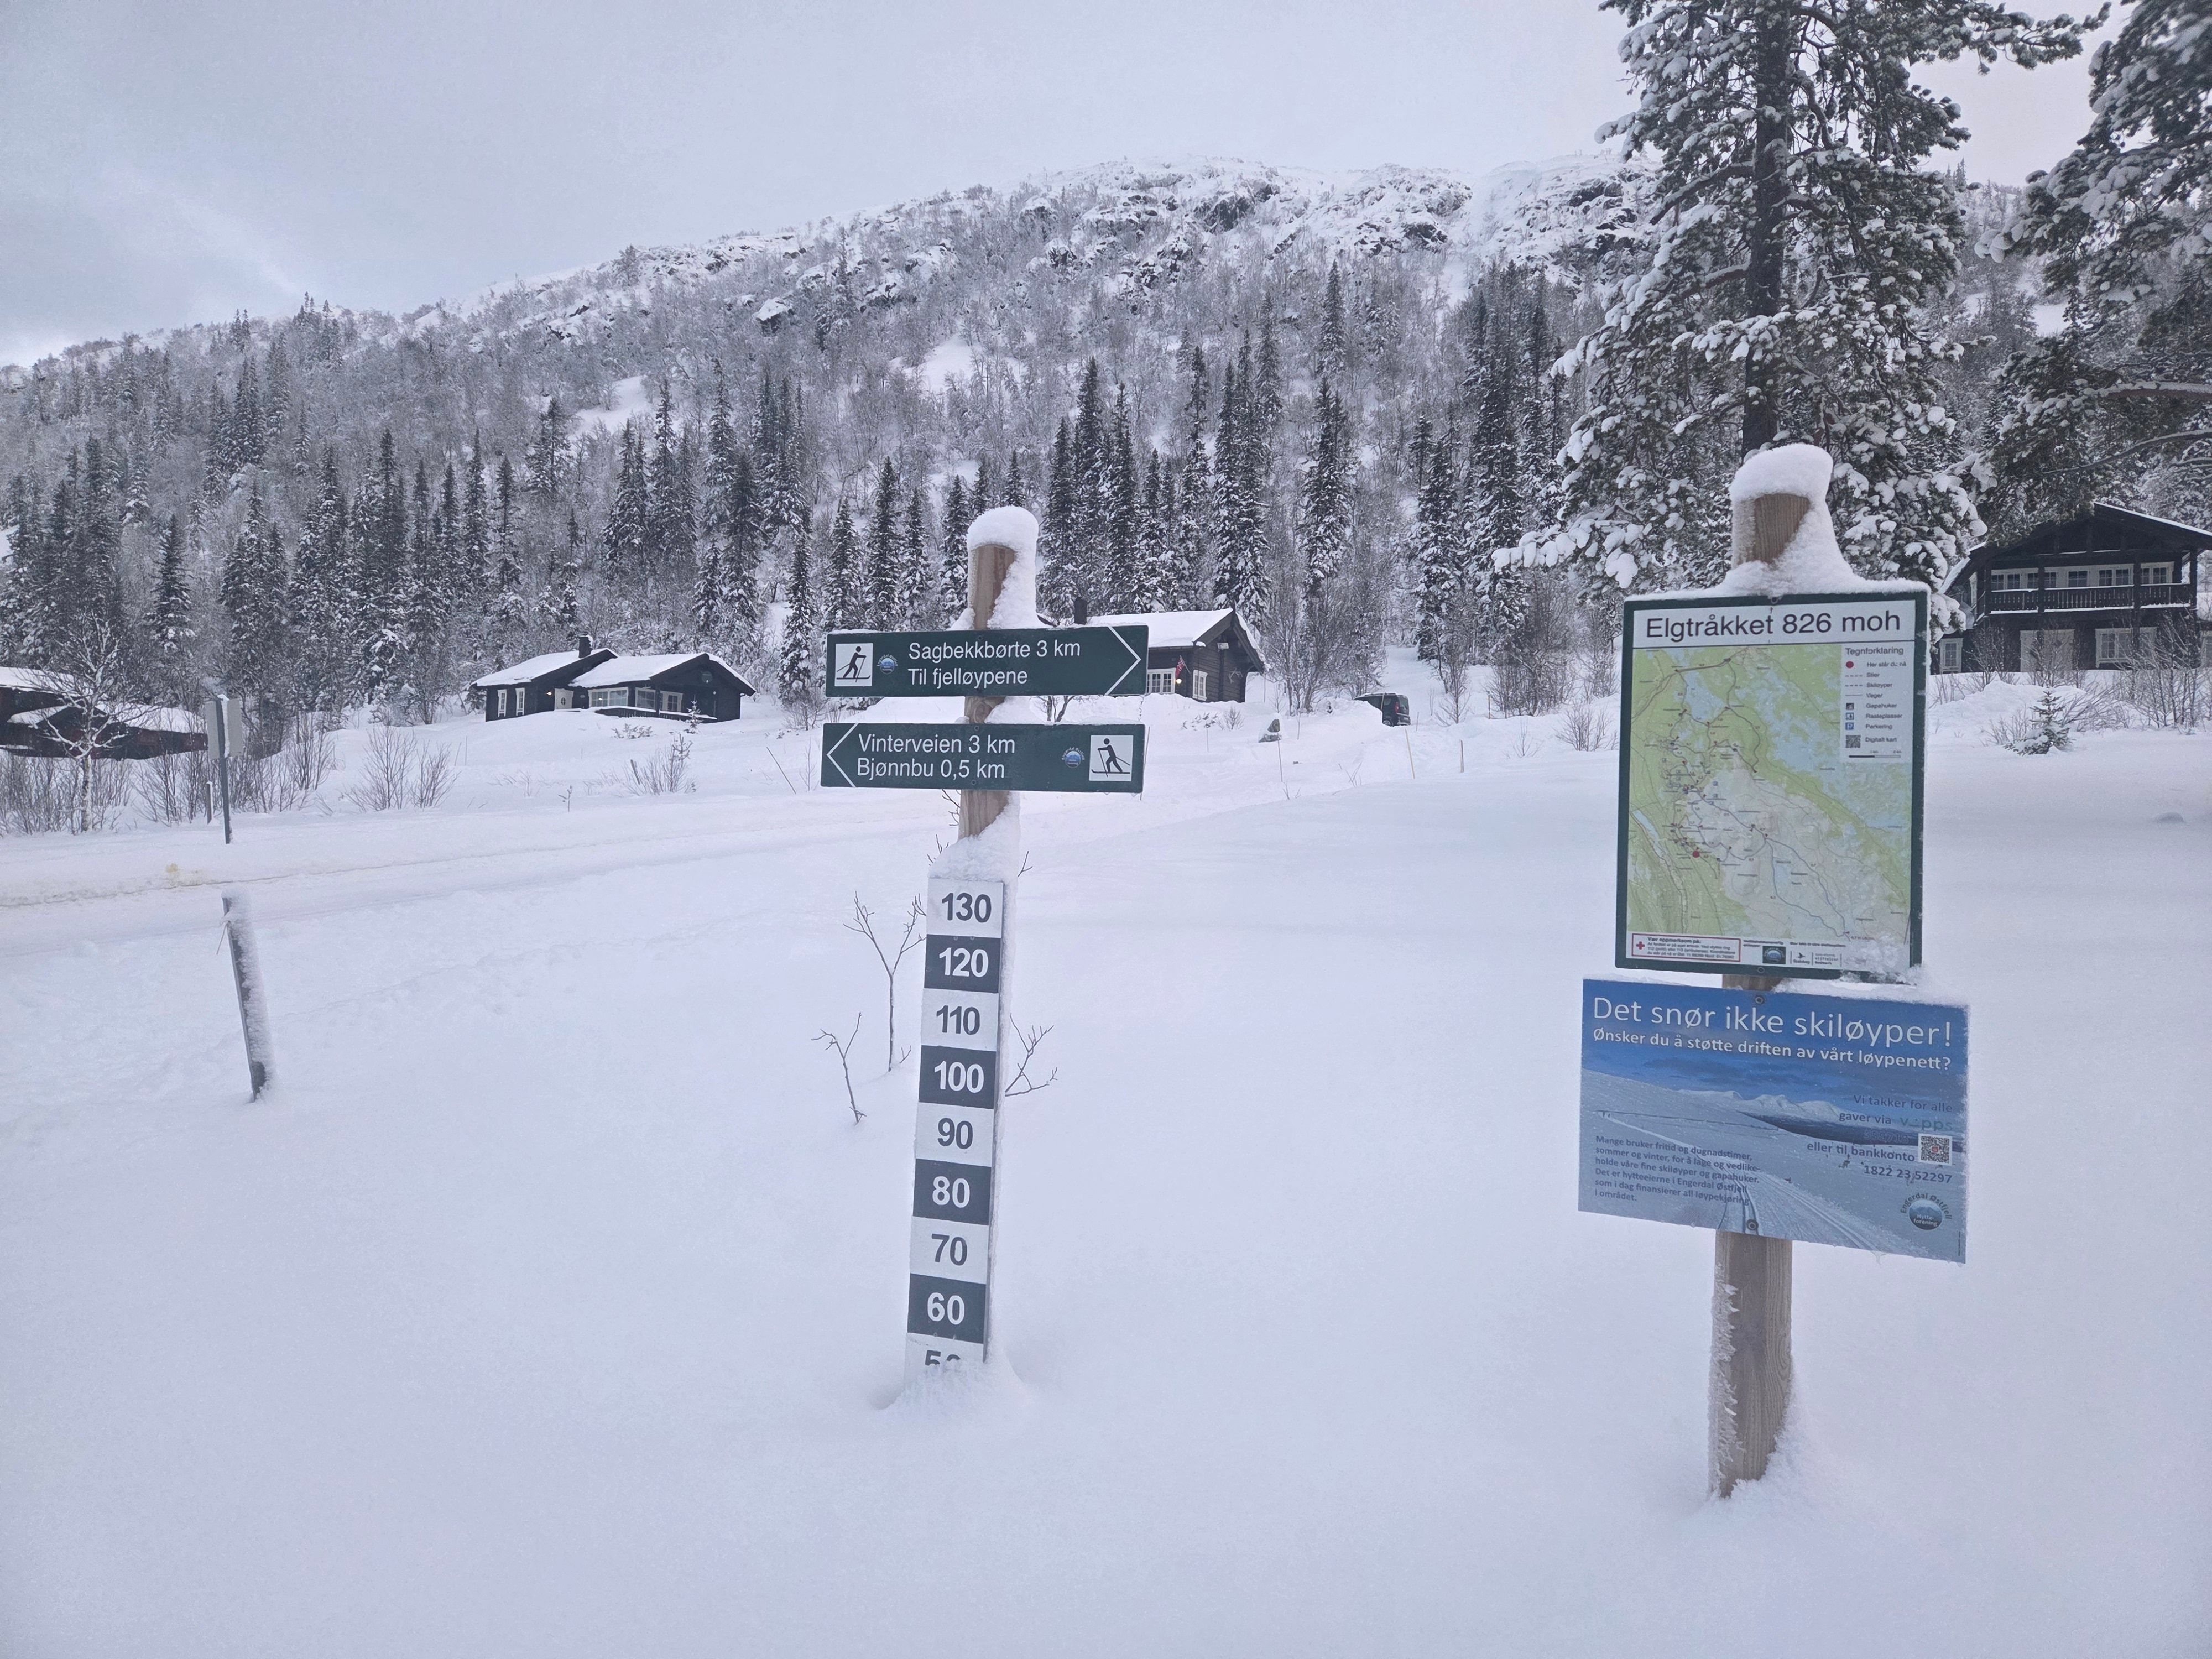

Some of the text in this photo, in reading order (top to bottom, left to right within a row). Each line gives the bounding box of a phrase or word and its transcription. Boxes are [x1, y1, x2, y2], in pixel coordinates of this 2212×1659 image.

[1646, 610, 1901, 643] Elgtråkket 826 moh
[909, 639, 1081, 663] Sagbekkbørte 3 km
[1845, 647, 1904, 656] Tegnforklaring
[908, 667, 1027, 690] Til fjelløypene
[858, 734, 1015, 753] Vinterveien 3 km
[857, 758, 1005, 780] Bjønnbu 0,5 km
[942, 893, 992, 923] 130
[939, 947, 989, 978] 120
[936, 1005, 980, 1035] 110
[1594, 997, 1952, 1048] Det snør ikke skiløyper!
[1594, 1029, 1951, 1070] Ønsker du å støtte driften av vårt løypenett?
[934, 1061, 984, 1093] 100
[1854, 1095, 1952, 1112] Vi takker for alle
[1839, 1112, 1871, 1122] gaver
[1875, 1115, 1892, 1124] via
[937, 1118, 973, 1149] 90
[1595, 1147, 1629, 1157] sommer
[1631, 1151, 1641, 1160] og
[1644, 1152, 1670, 1162] vinter,
[1672, 1155, 1684, 1163] for
[1694, 1158, 1711, 1167] lage
[1714, 1161, 1724, 1170] og
[1726, 1161, 1761, 1172] vedlike-
[1596, 1136, 1752, 1161] Mange bruker fritid og dugnadstimer,
[1807, 1141, 1915, 1162] eller til bankkonto
[1595, 1157, 1760, 1183] holde våre fine skiløyper og gapahuker.
[1595, 1168, 1610, 1176] Det
[1623, 1171, 1670, 1184] hytteeierne
[1678, 1178, 1714, 1189] Engerdal
[1717, 1183, 1747, 1193] Østfjell
[1864, 1165, 1952, 1183] 1822 23 52297
[932, 1176, 971, 1208] 80
[1600, 1192, 1637, 1202] området.
[1619, 1181, 1634, 1190] dag
[1636, 1183, 1681, 1196] finansierer
[1695, 1191, 1750, 1206] løypekjøring
[1900, 1192, 1952, 1219] Engerdal Østfjell
[1914, 1218, 1938, 1227] forening
[931, 1234, 967, 1266] 70
[927, 1292, 964, 1325] 60
[925, 1349, 961, 1366] 5
